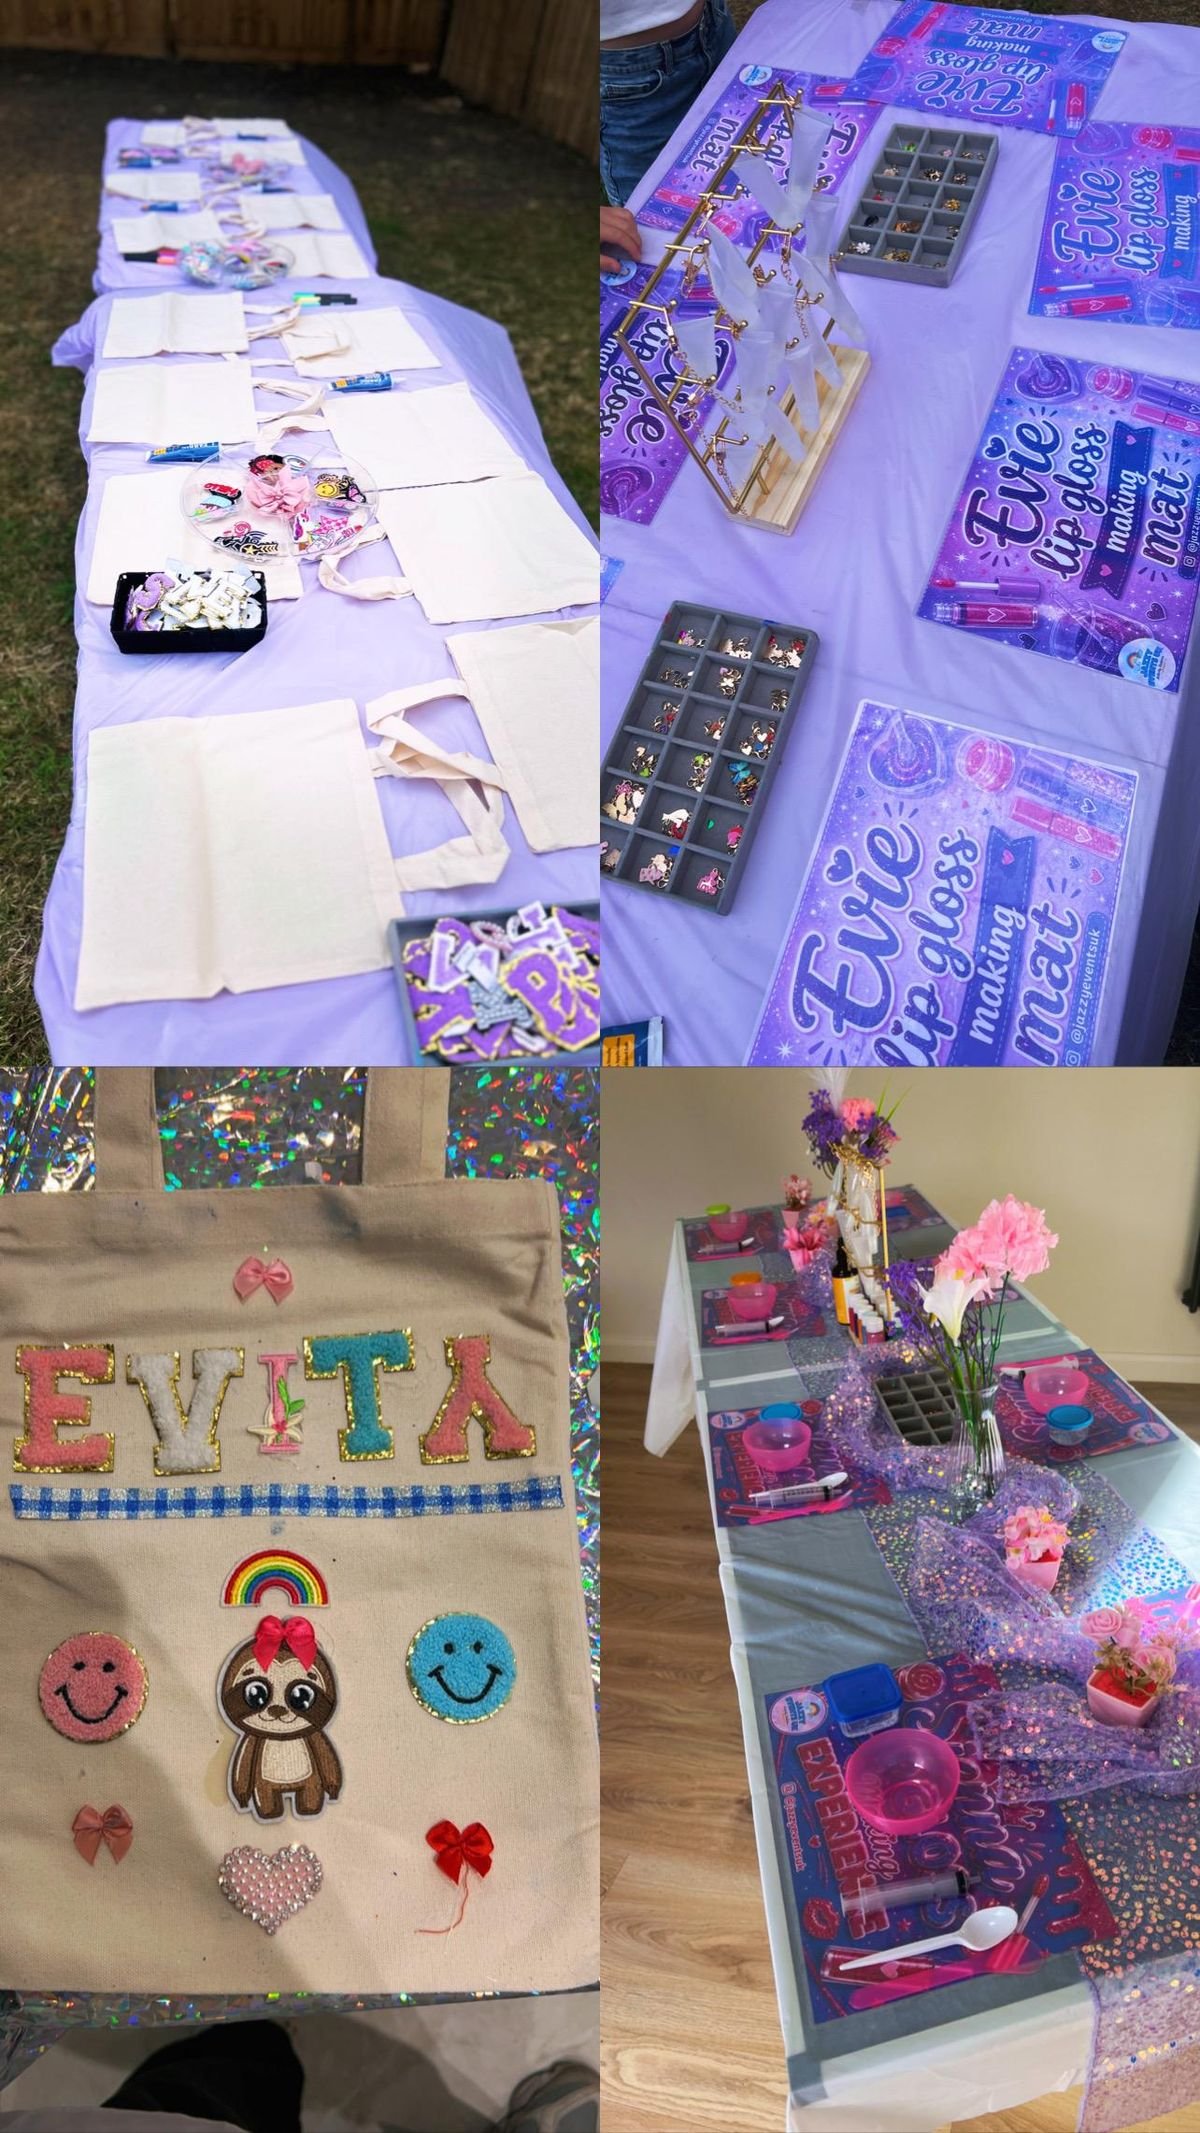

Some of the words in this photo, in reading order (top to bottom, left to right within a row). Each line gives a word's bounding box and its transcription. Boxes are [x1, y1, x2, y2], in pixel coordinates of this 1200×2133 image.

[923, 50, 1003, 80] gloss
[964, 18, 1043, 41] mat
[964, 35, 1032, 55] making
[998, 57, 1052, 87] lip
[914, 69, 1026, 118] Evie
[691, 116, 742, 174] mat
[1050, 167, 1121, 262] Evie
[1117, 165, 1170, 230] gloss
[1170, 193, 1198, 251] making
[1115, 230, 1167, 276] lip
[962, 416, 1063, 550] Evie
[1052, 420, 1110, 517] gloss
[1105, 467, 1149, 555] making
[1028, 513, 1096, 582] lip
[1140, 465, 1192, 569] mat
[788, 818, 926, 1037] Evie
[904, 826, 982, 984] gloss
[968, 903, 1029, 1046] making
[1010, 898, 1085, 1067] mat
[1069, 926, 1102, 1046] @jazzyeventsuk
[872, 980, 958, 1067] lip
